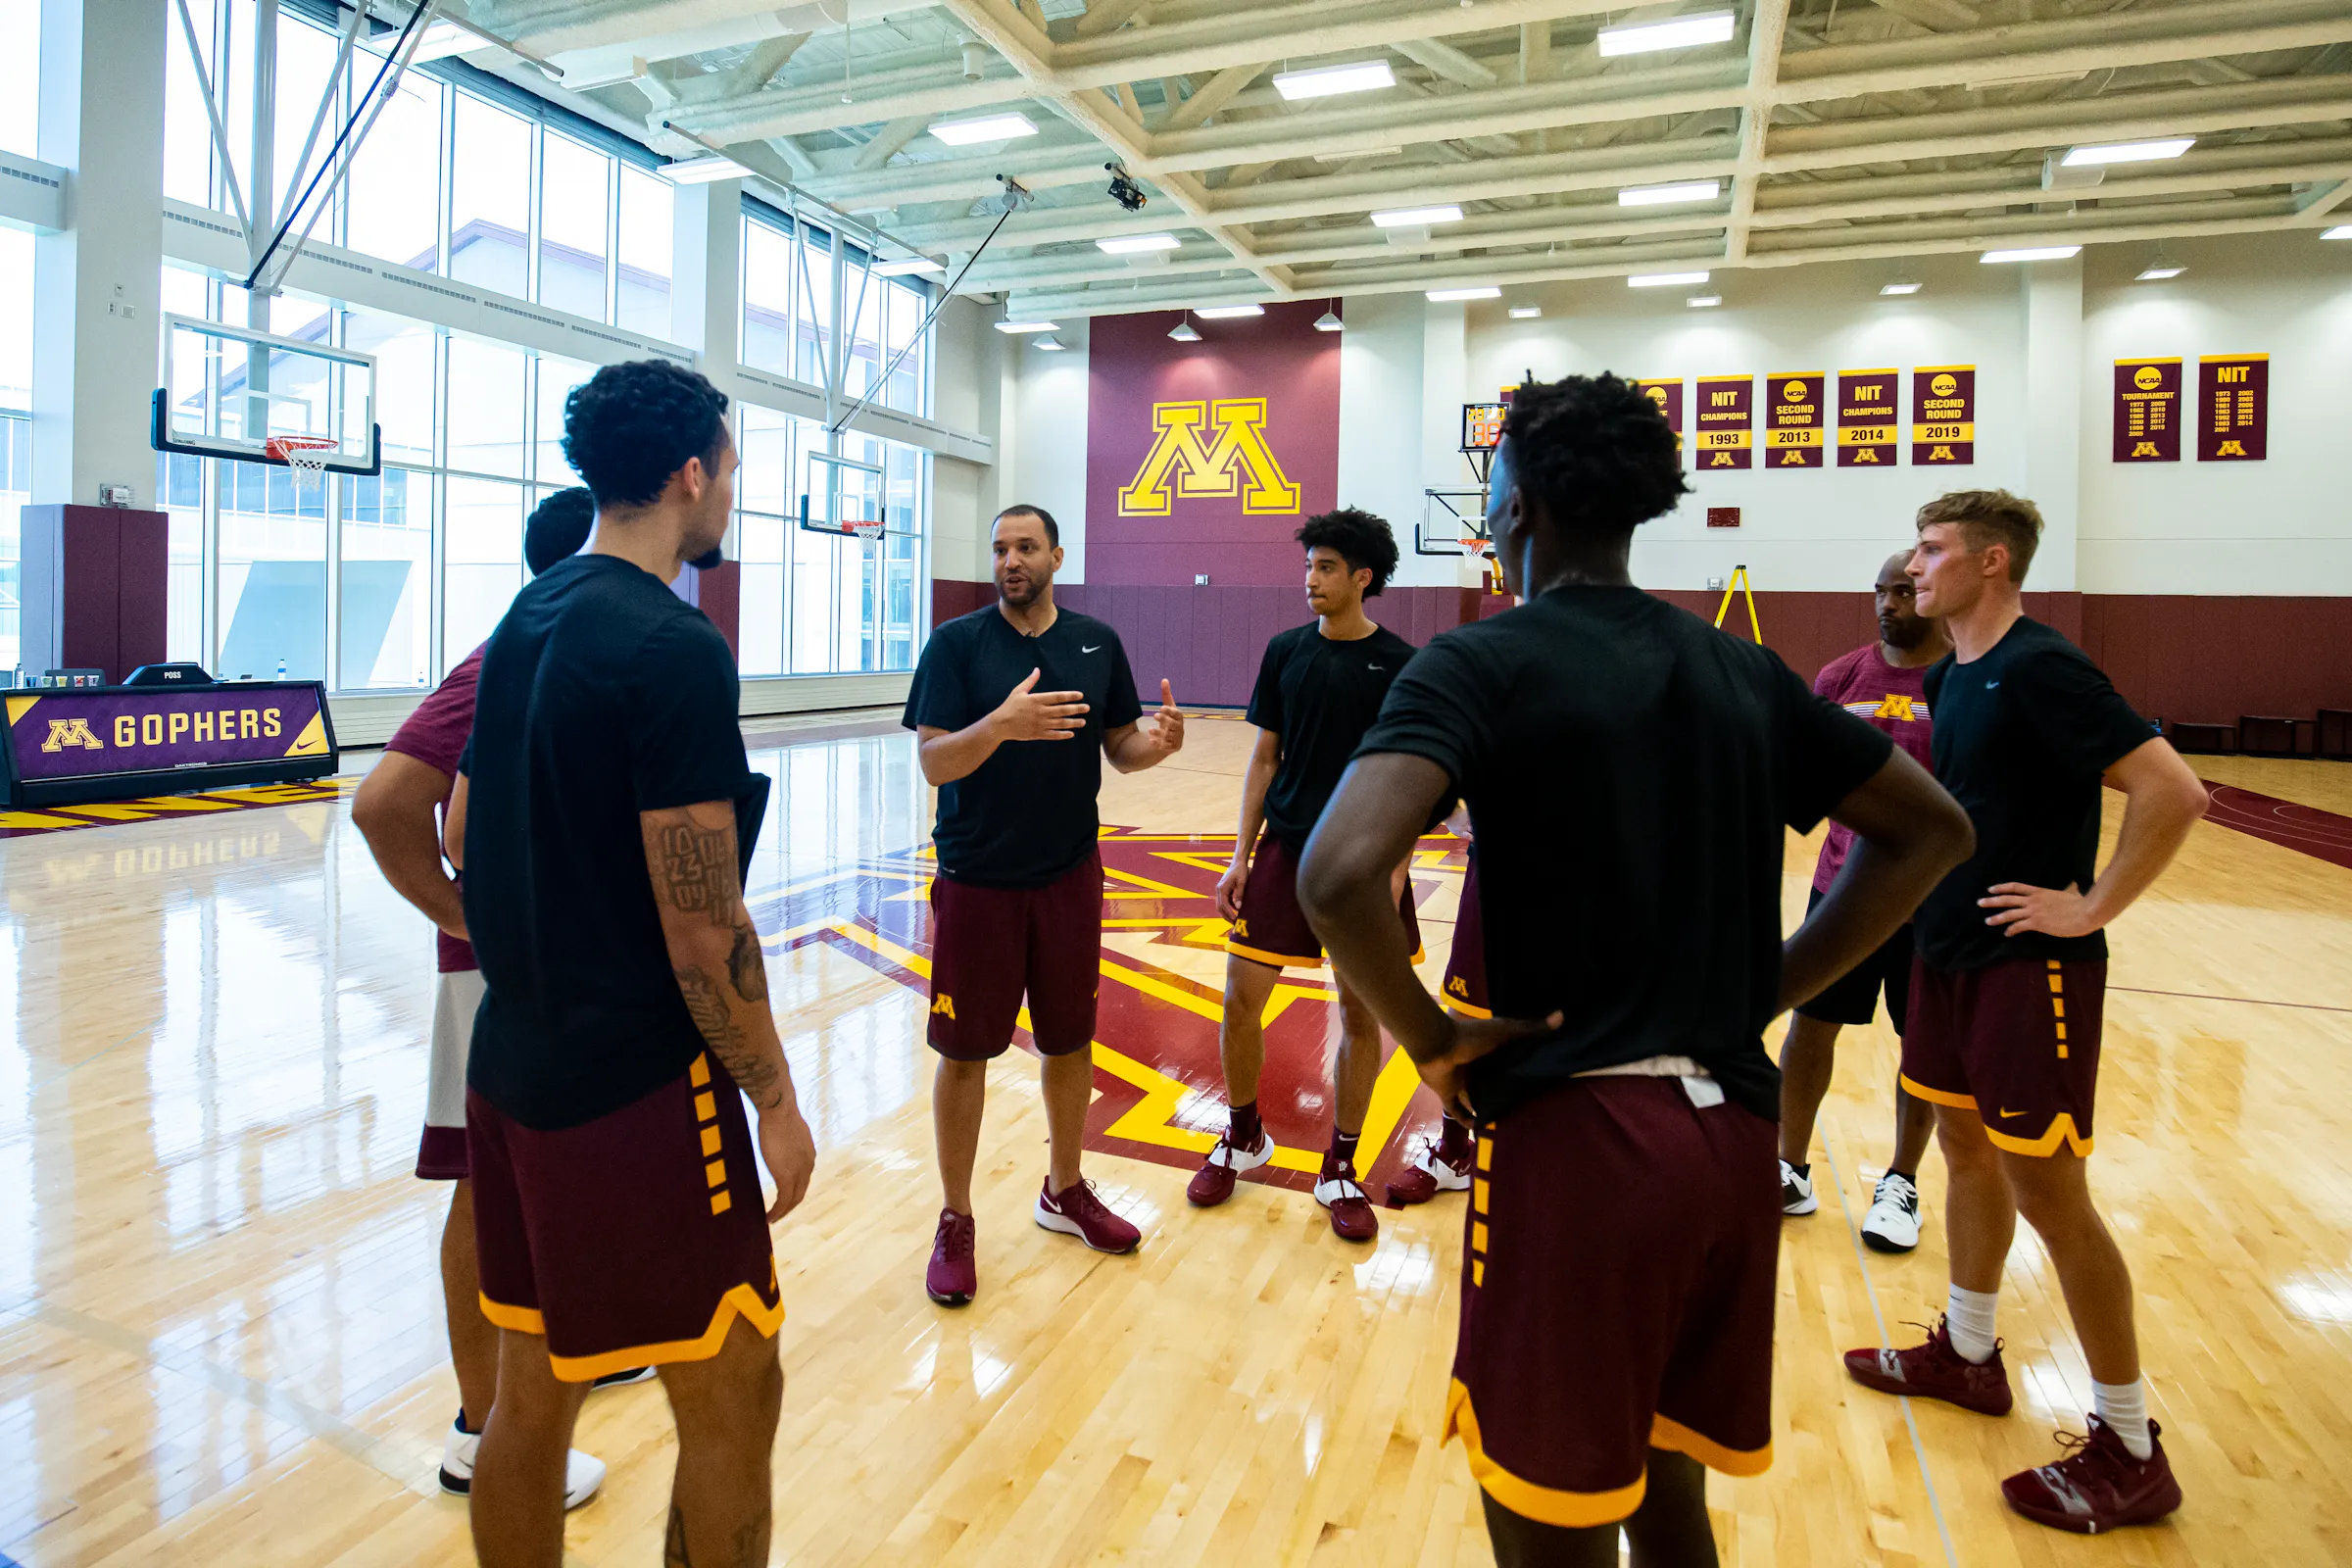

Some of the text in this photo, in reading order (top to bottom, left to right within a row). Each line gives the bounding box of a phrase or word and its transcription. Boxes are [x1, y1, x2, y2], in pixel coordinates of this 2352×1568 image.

[2218, 367, 2250, 383] NIT
[1711, 391, 1738, 407] NIT
[1854, 385, 1883, 401] NIT
[1776, 404, 1815, 415] SECOND
[1924, 399, 1965, 409] SECOND
[1700, 412, 1747, 422] CHAMPIONS
[1842, 407, 1893, 416] CHAMPIONS
[1926, 409, 1962, 419] ROUND
[1778, 415, 1812, 425] ROUND
[1709, 433, 1740, 445] 1993
[1779, 431, 1810, 443] 2013
[1851, 429, 1884, 441] 2014
[1926, 426, 1960, 438] 2019
[1929, 445, 1956, 461] M
[2132, 441, 2161, 457] M
[2217, 440, 2247, 456] M
[1118, 397, 1300, 516] M
[1710, 452, 1735, 466] M
[1781, 450, 1807, 466] M
[1853, 448, 1880, 463] M
[165, 670, 181, 679] POSS
[1874, 693, 1916, 721] M
[41, 708, 281, 753] M GOPHERS
[931, 993, 956, 1020] M
